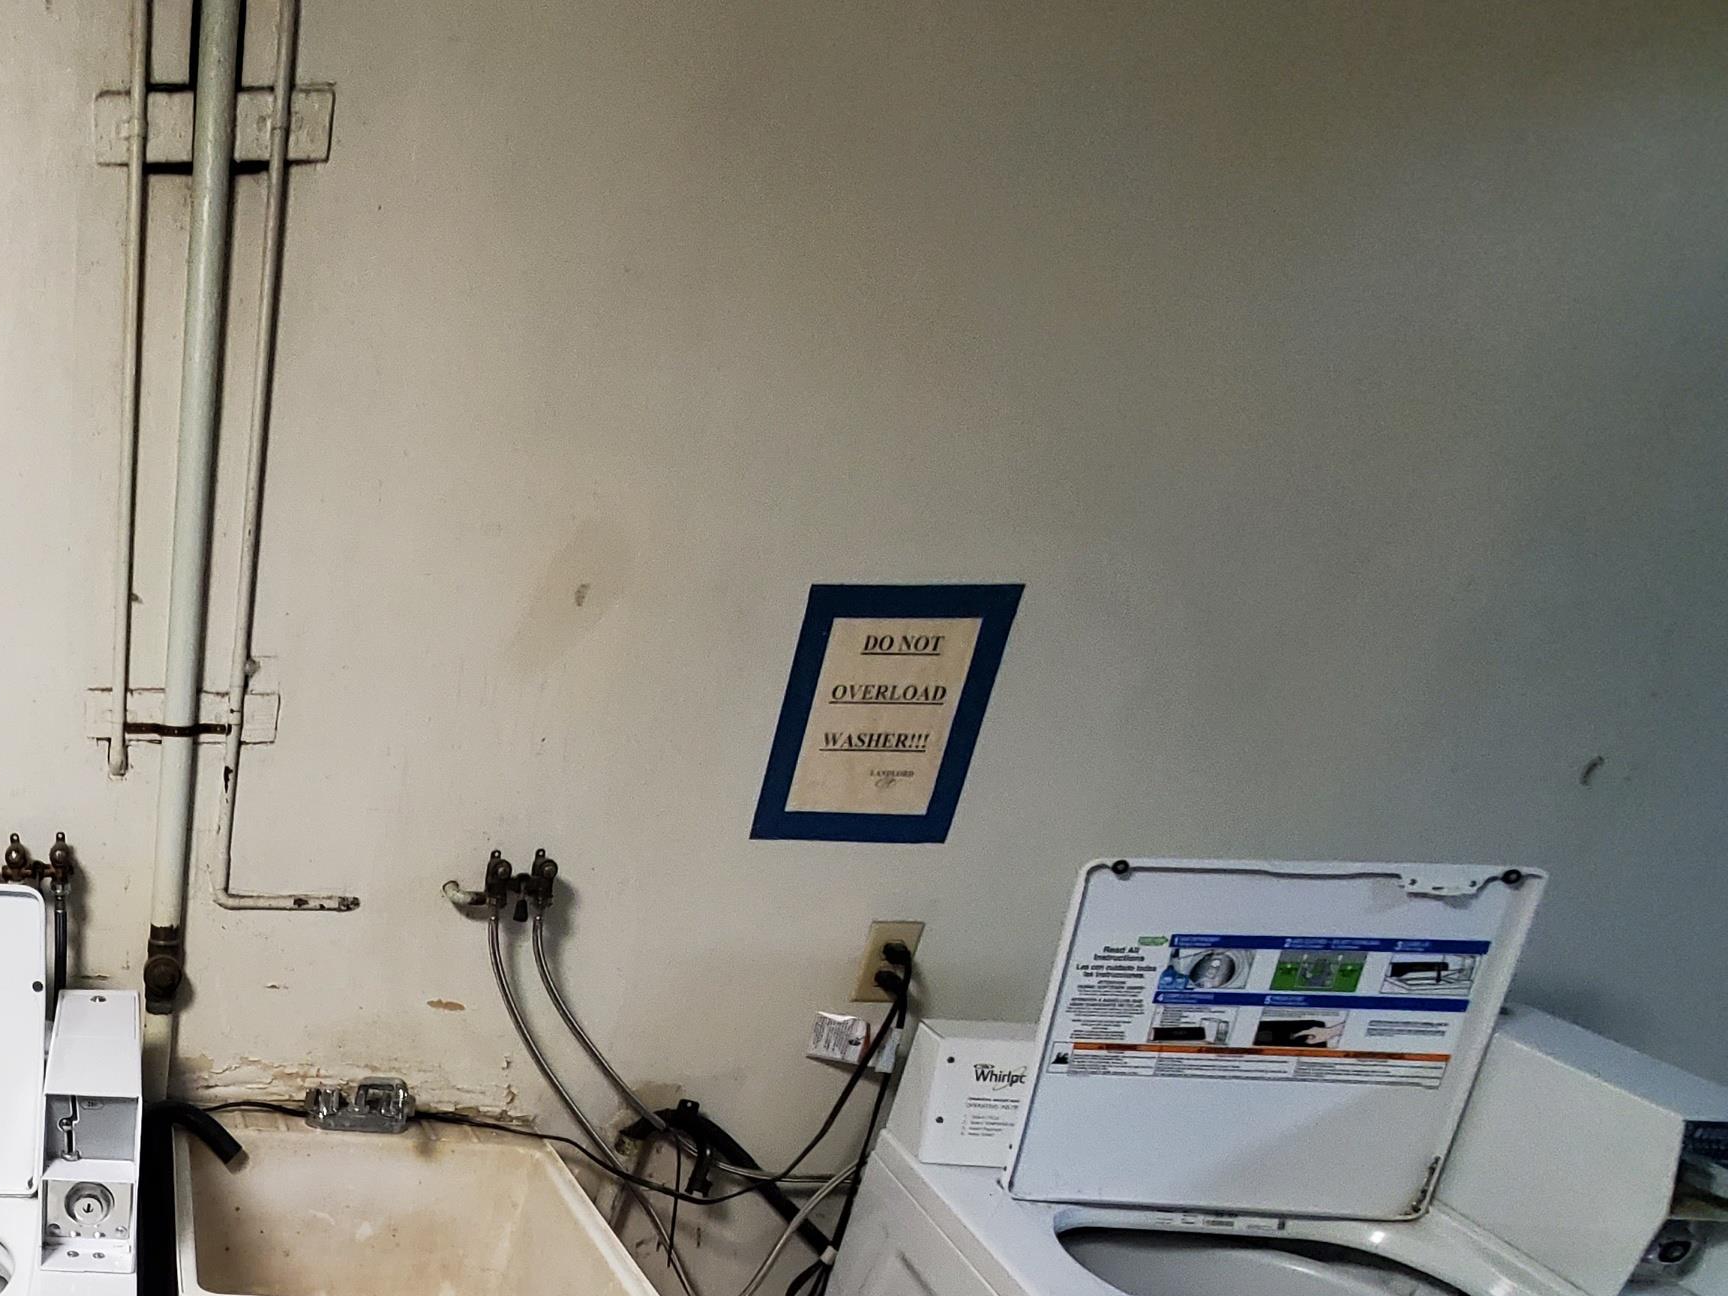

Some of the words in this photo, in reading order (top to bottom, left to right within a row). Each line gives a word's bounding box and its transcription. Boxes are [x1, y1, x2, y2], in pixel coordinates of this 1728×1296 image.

[863, 635, 894, 652] DO
[898, 635, 945, 652] NOT
[831, 684, 947, 701] OVERLOAD
[823, 732, 930, 749] WASHER!!!
